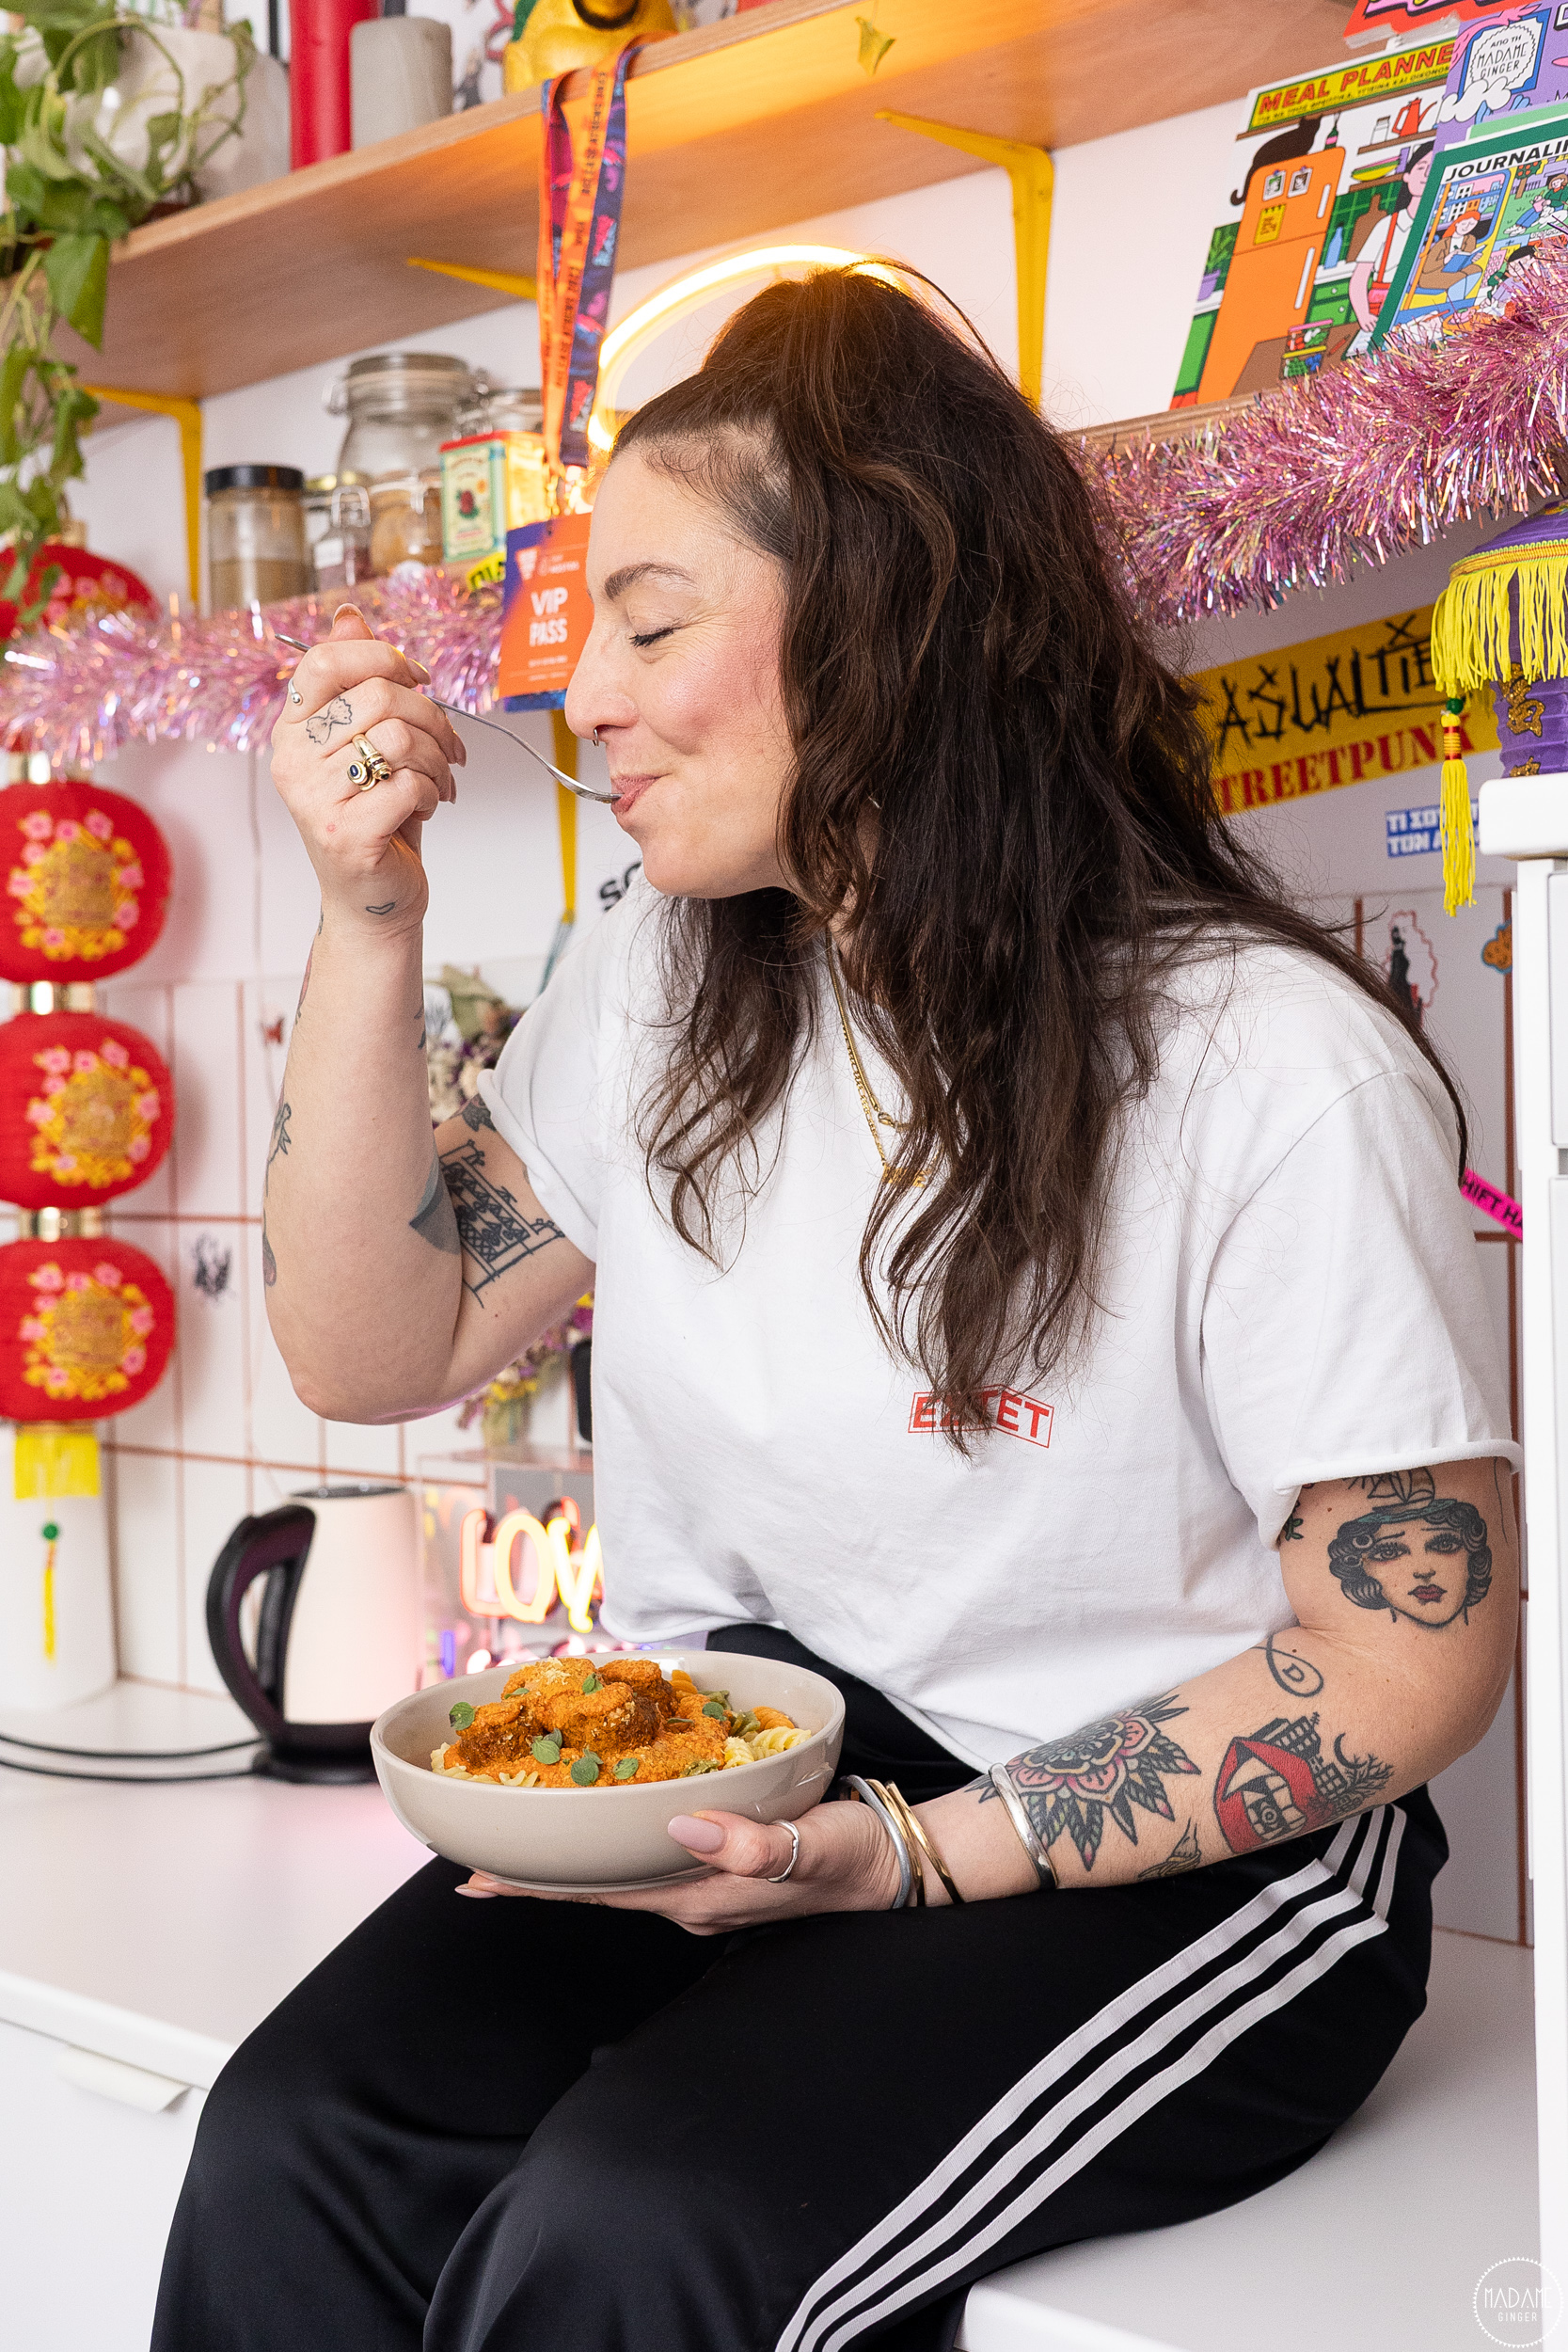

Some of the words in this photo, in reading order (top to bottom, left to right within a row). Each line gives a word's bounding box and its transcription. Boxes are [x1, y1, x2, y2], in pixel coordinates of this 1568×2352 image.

[1259, 79, 1331, 114] MEAL
[1339, 42, 1456, 92] PLANNE
[1477, 41, 1528, 68] MADAME
[1481, 59, 1520, 79] GINGER
[531, 587, 568, 616] VIP
[529, 617, 567, 647] PASS
[1219, 614, 1439, 755] ASUALTIE
[1214, 712, 1474, 815] TREETPUN
[460, 1508, 604, 1633] LOV
